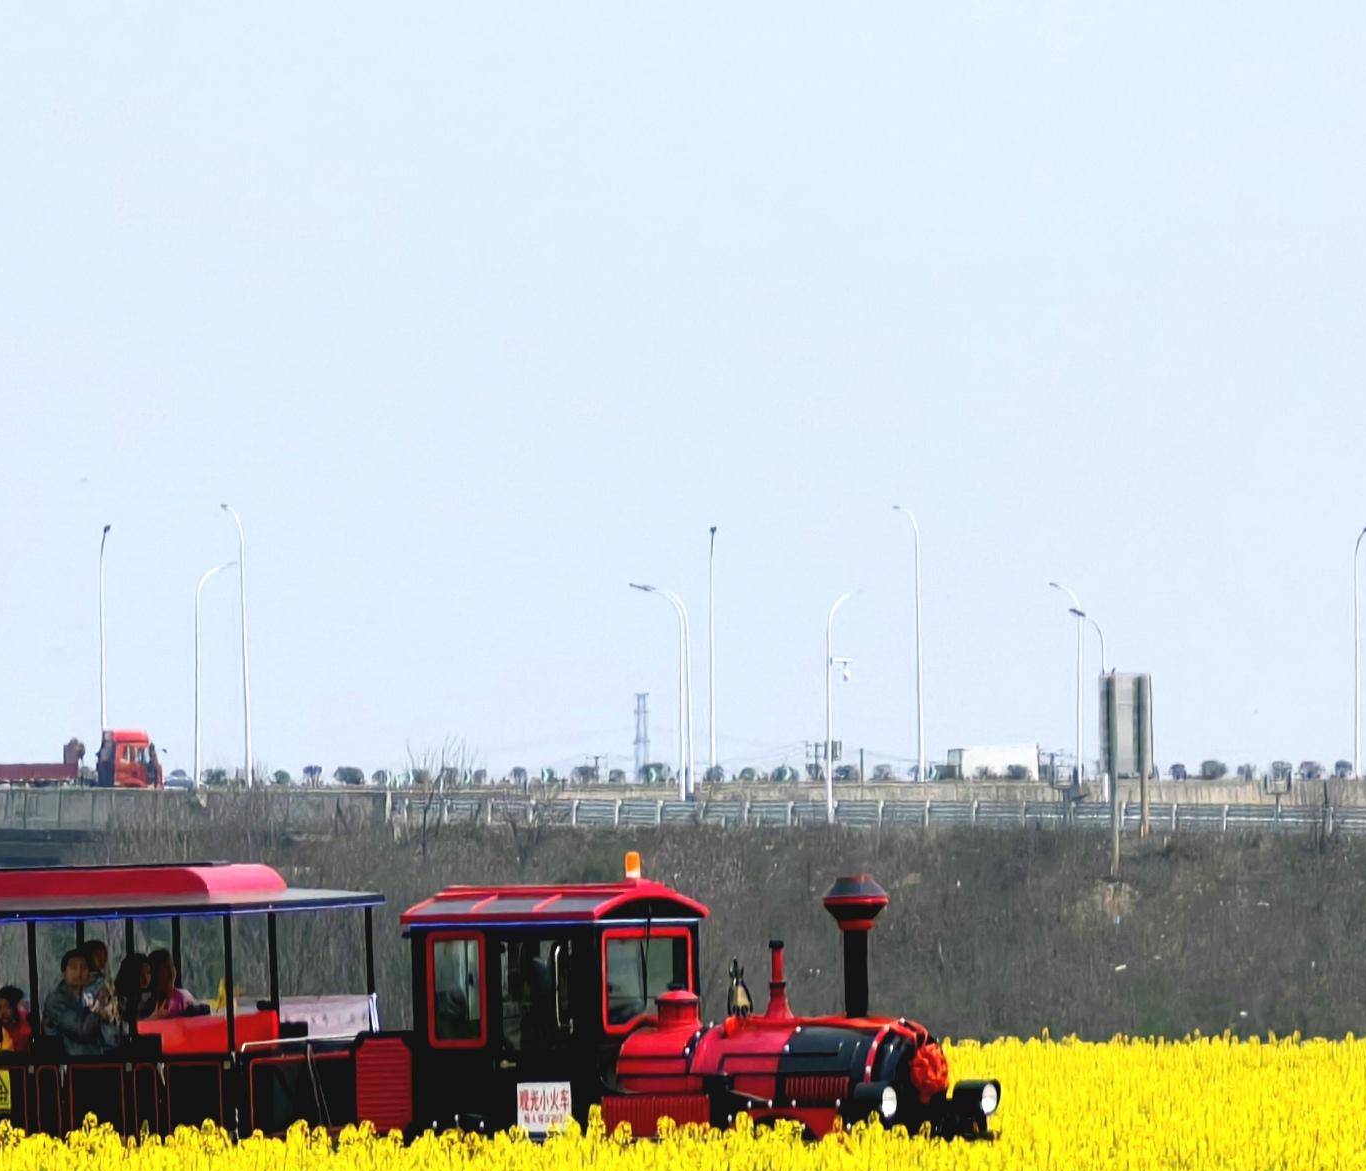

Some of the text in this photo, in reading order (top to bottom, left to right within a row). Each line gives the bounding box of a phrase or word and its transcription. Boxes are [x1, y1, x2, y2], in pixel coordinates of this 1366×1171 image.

[519, 1087, 569, 1112] 观光小火车
